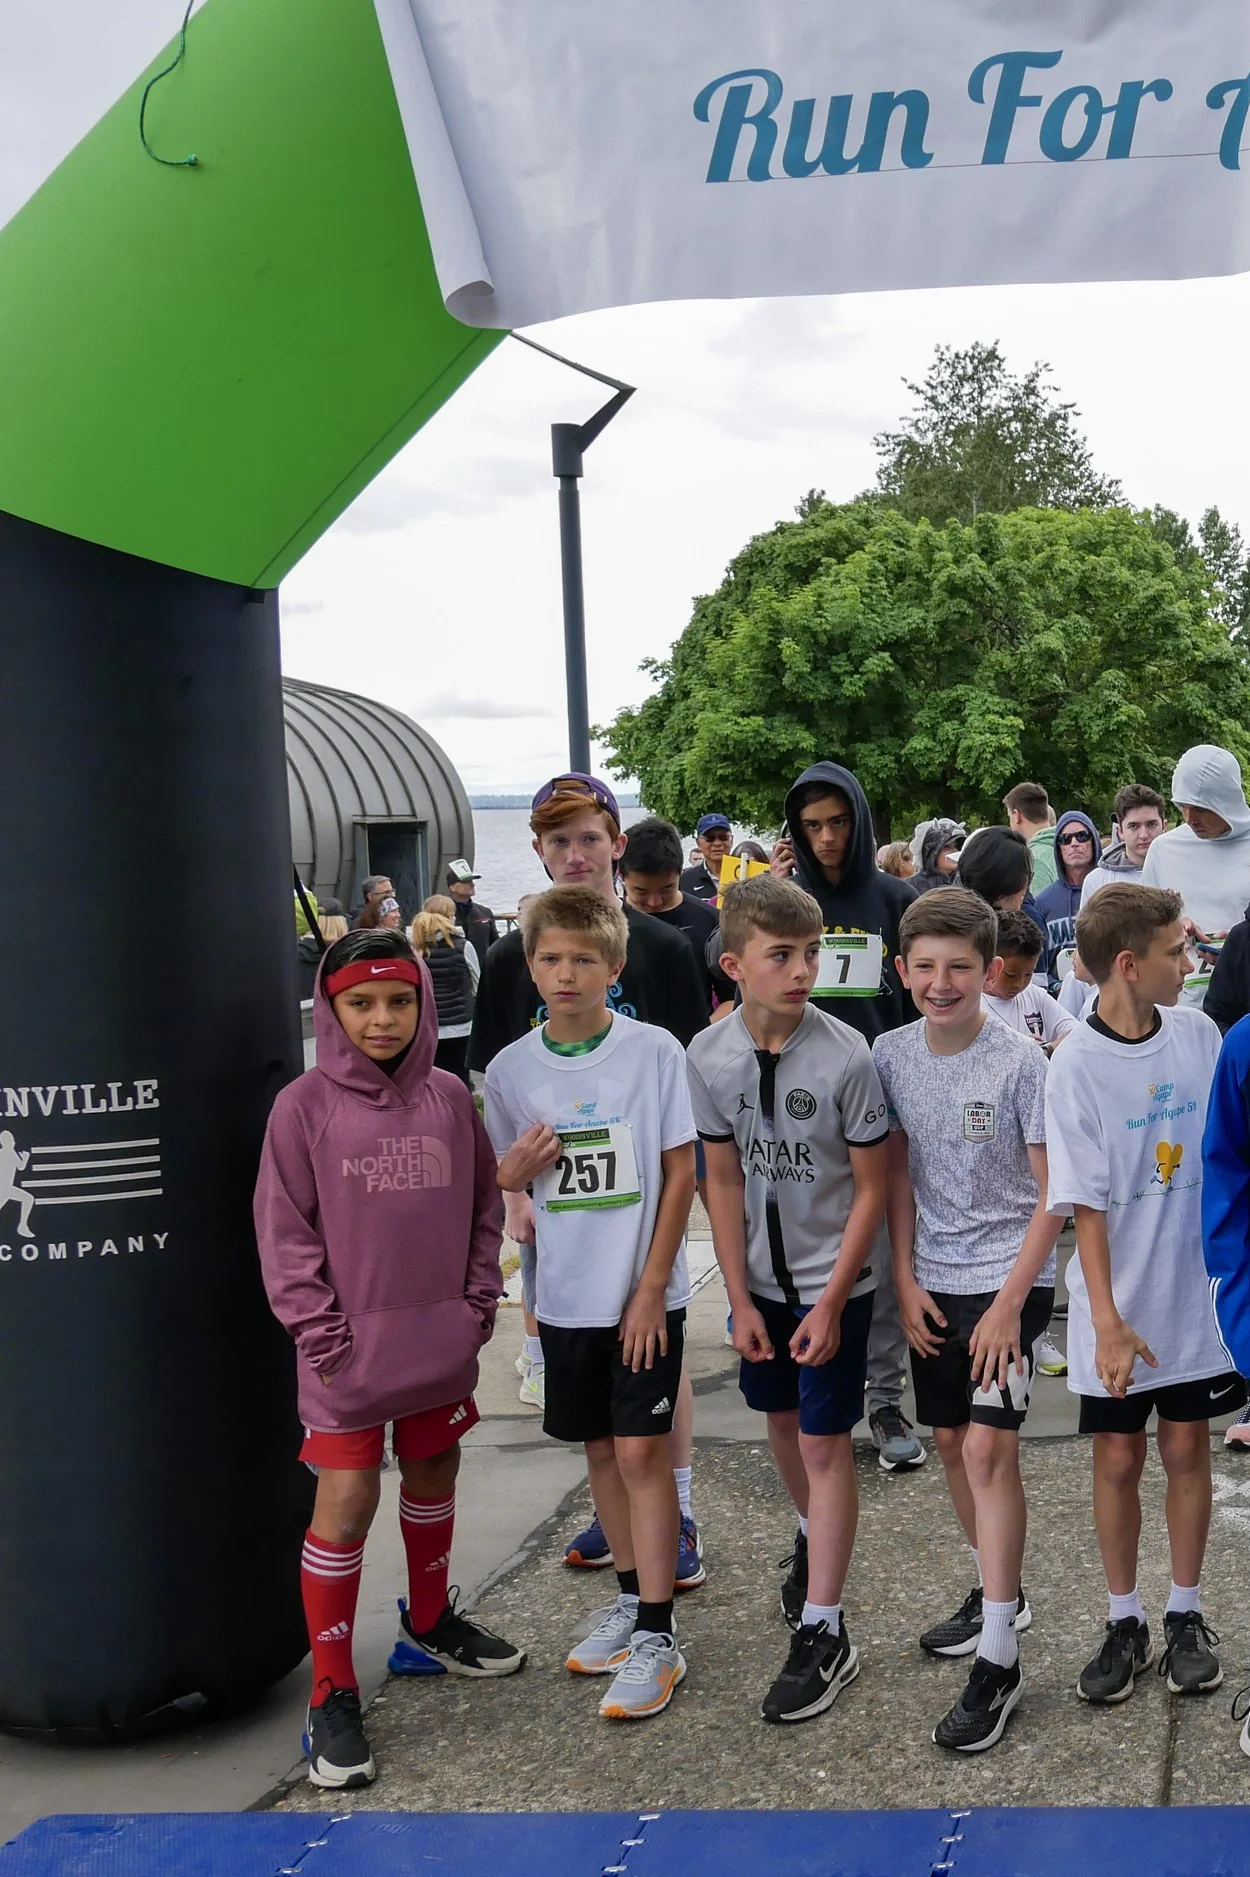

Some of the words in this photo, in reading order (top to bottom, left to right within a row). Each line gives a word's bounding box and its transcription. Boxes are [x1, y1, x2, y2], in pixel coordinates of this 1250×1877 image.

[693, 68, 934, 182] Run
[968, 50, 1173, 165] For
[836, 954, 851, 984] 7
[0, 1079, 160, 1117] NVILLE
[1156, 1083, 1174, 1093] Camp
[967, 1110, 991, 1118] LABOR
[1126, 1118, 1146, 1130] Run
[1147, 1112, 1158, 1124] For
[1160, 1105, 1186, 1120] Agape
[377, 1136, 420, 1155] THE
[746, 1138, 814, 1166] ATAR
[342, 1154, 420, 1177] NORTH
[555, 1151, 616, 1195] 257
[367, 1172, 421, 1193] FACE
[0, 1232, 169, 1261] COMPANY
